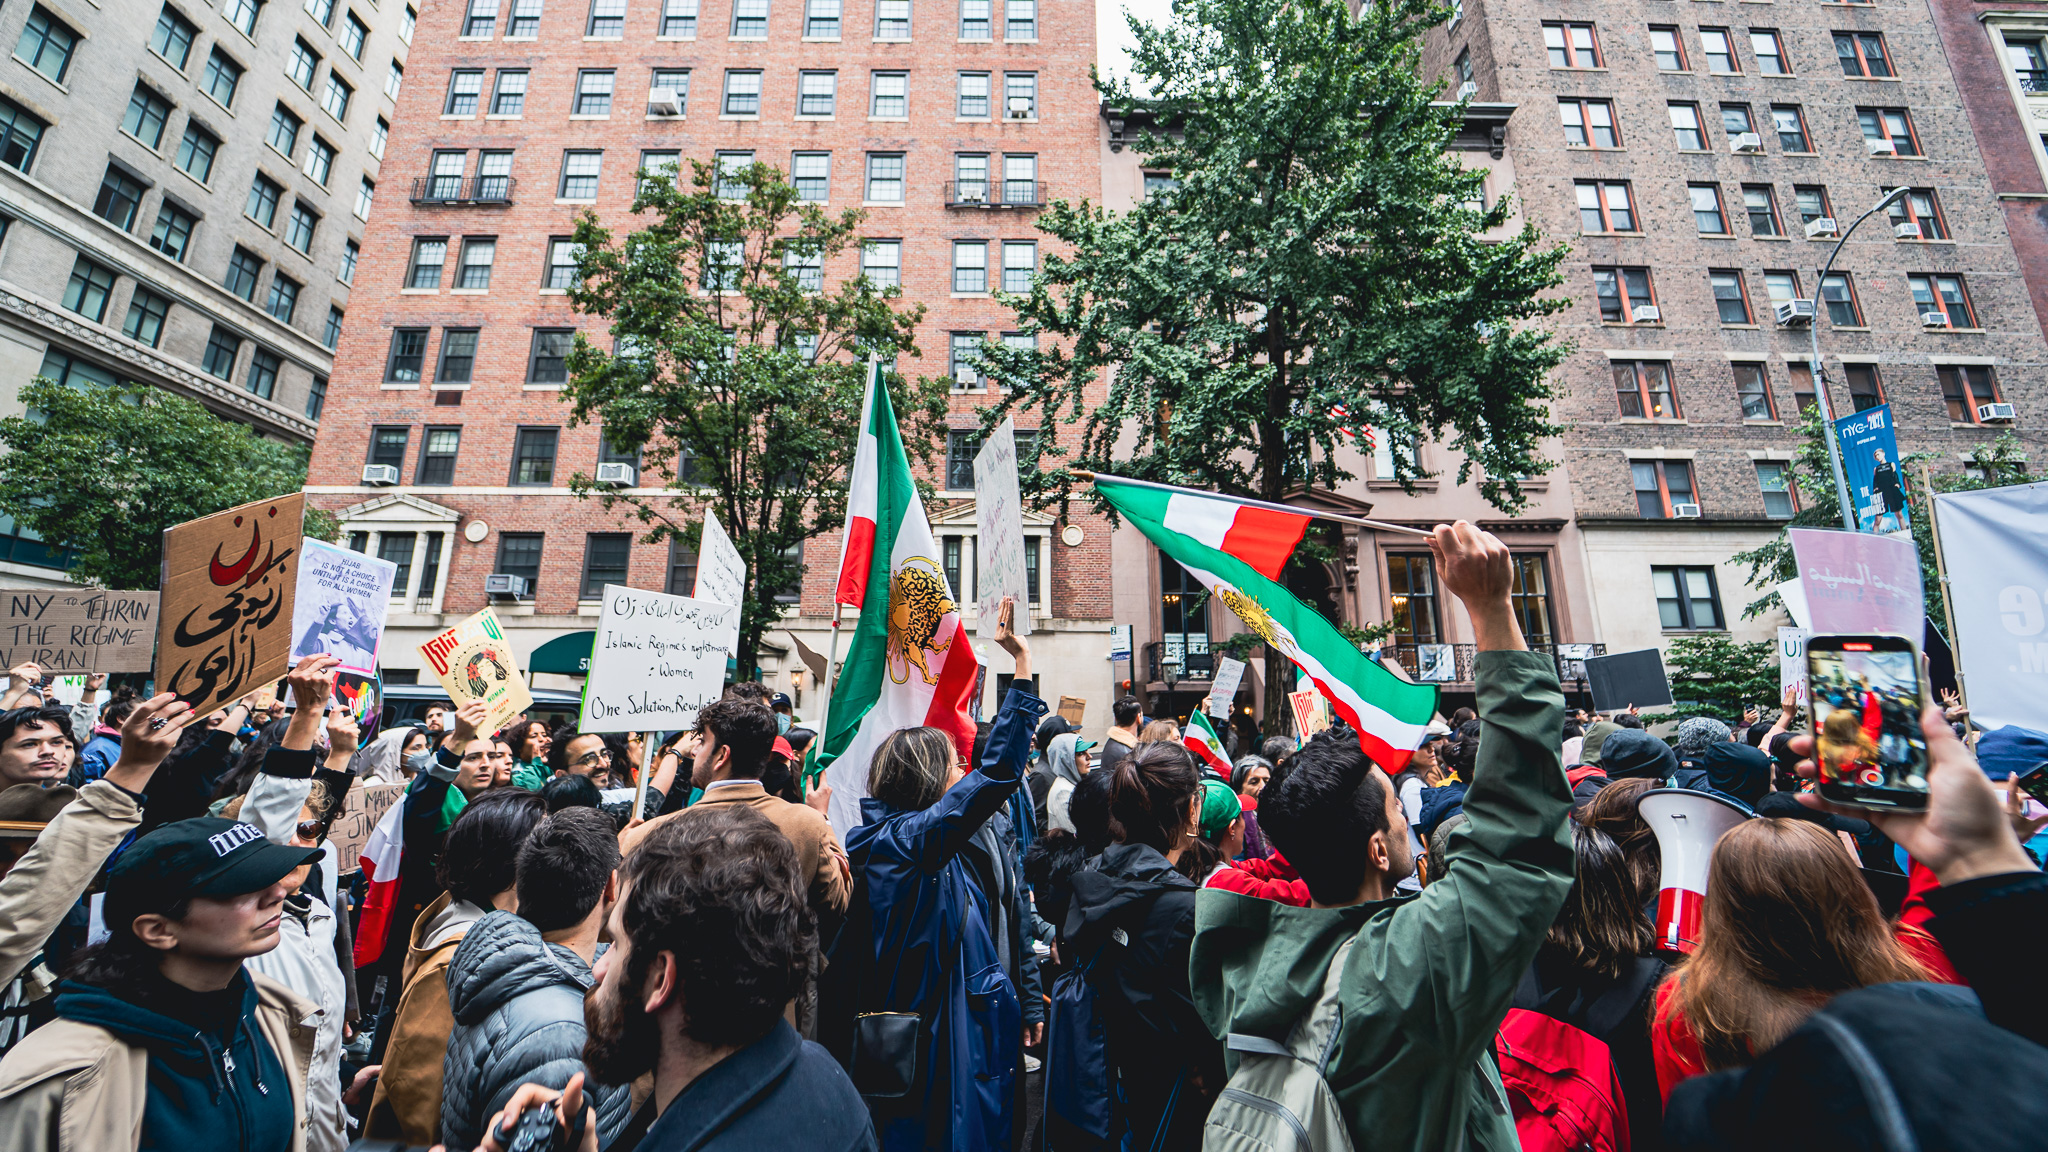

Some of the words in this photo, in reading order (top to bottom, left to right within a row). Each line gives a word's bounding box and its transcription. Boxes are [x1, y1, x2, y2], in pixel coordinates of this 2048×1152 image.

[330, 564, 345, 573] NOT
[351, 570, 376, 583] CHOICE
[341, 558, 361, 569] HIJAB
[312, 568, 333, 580] UNTIL
[342, 576, 350, 584] IS
[356, 580, 381, 592] CHOICE
[317, 578, 333, 588] FOR
[333, 583, 345, 592] ALL
[346, 586, 372, 598] WOMEN
[11, 594, 55, 620] NY
[64, 597, 78, 606] TO
[80, 594, 151, 624] TEHRAN
[613, 594, 637, 620] زن
[6, 623, 57, 646] THE
[70, 625, 144, 648] REGIME
[605, 630, 642, 650] Islamic
[649, 634, 687, 658] Regime's
[690, 640, 729, 660] nightmare
[31, 648, 87, 670] IRAN
[659, 662, 694, 680] Women
[348, 688, 375, 717] QUEER
[487, 686, 506, 703] WOMAN
[591, 696, 620, 720] One
